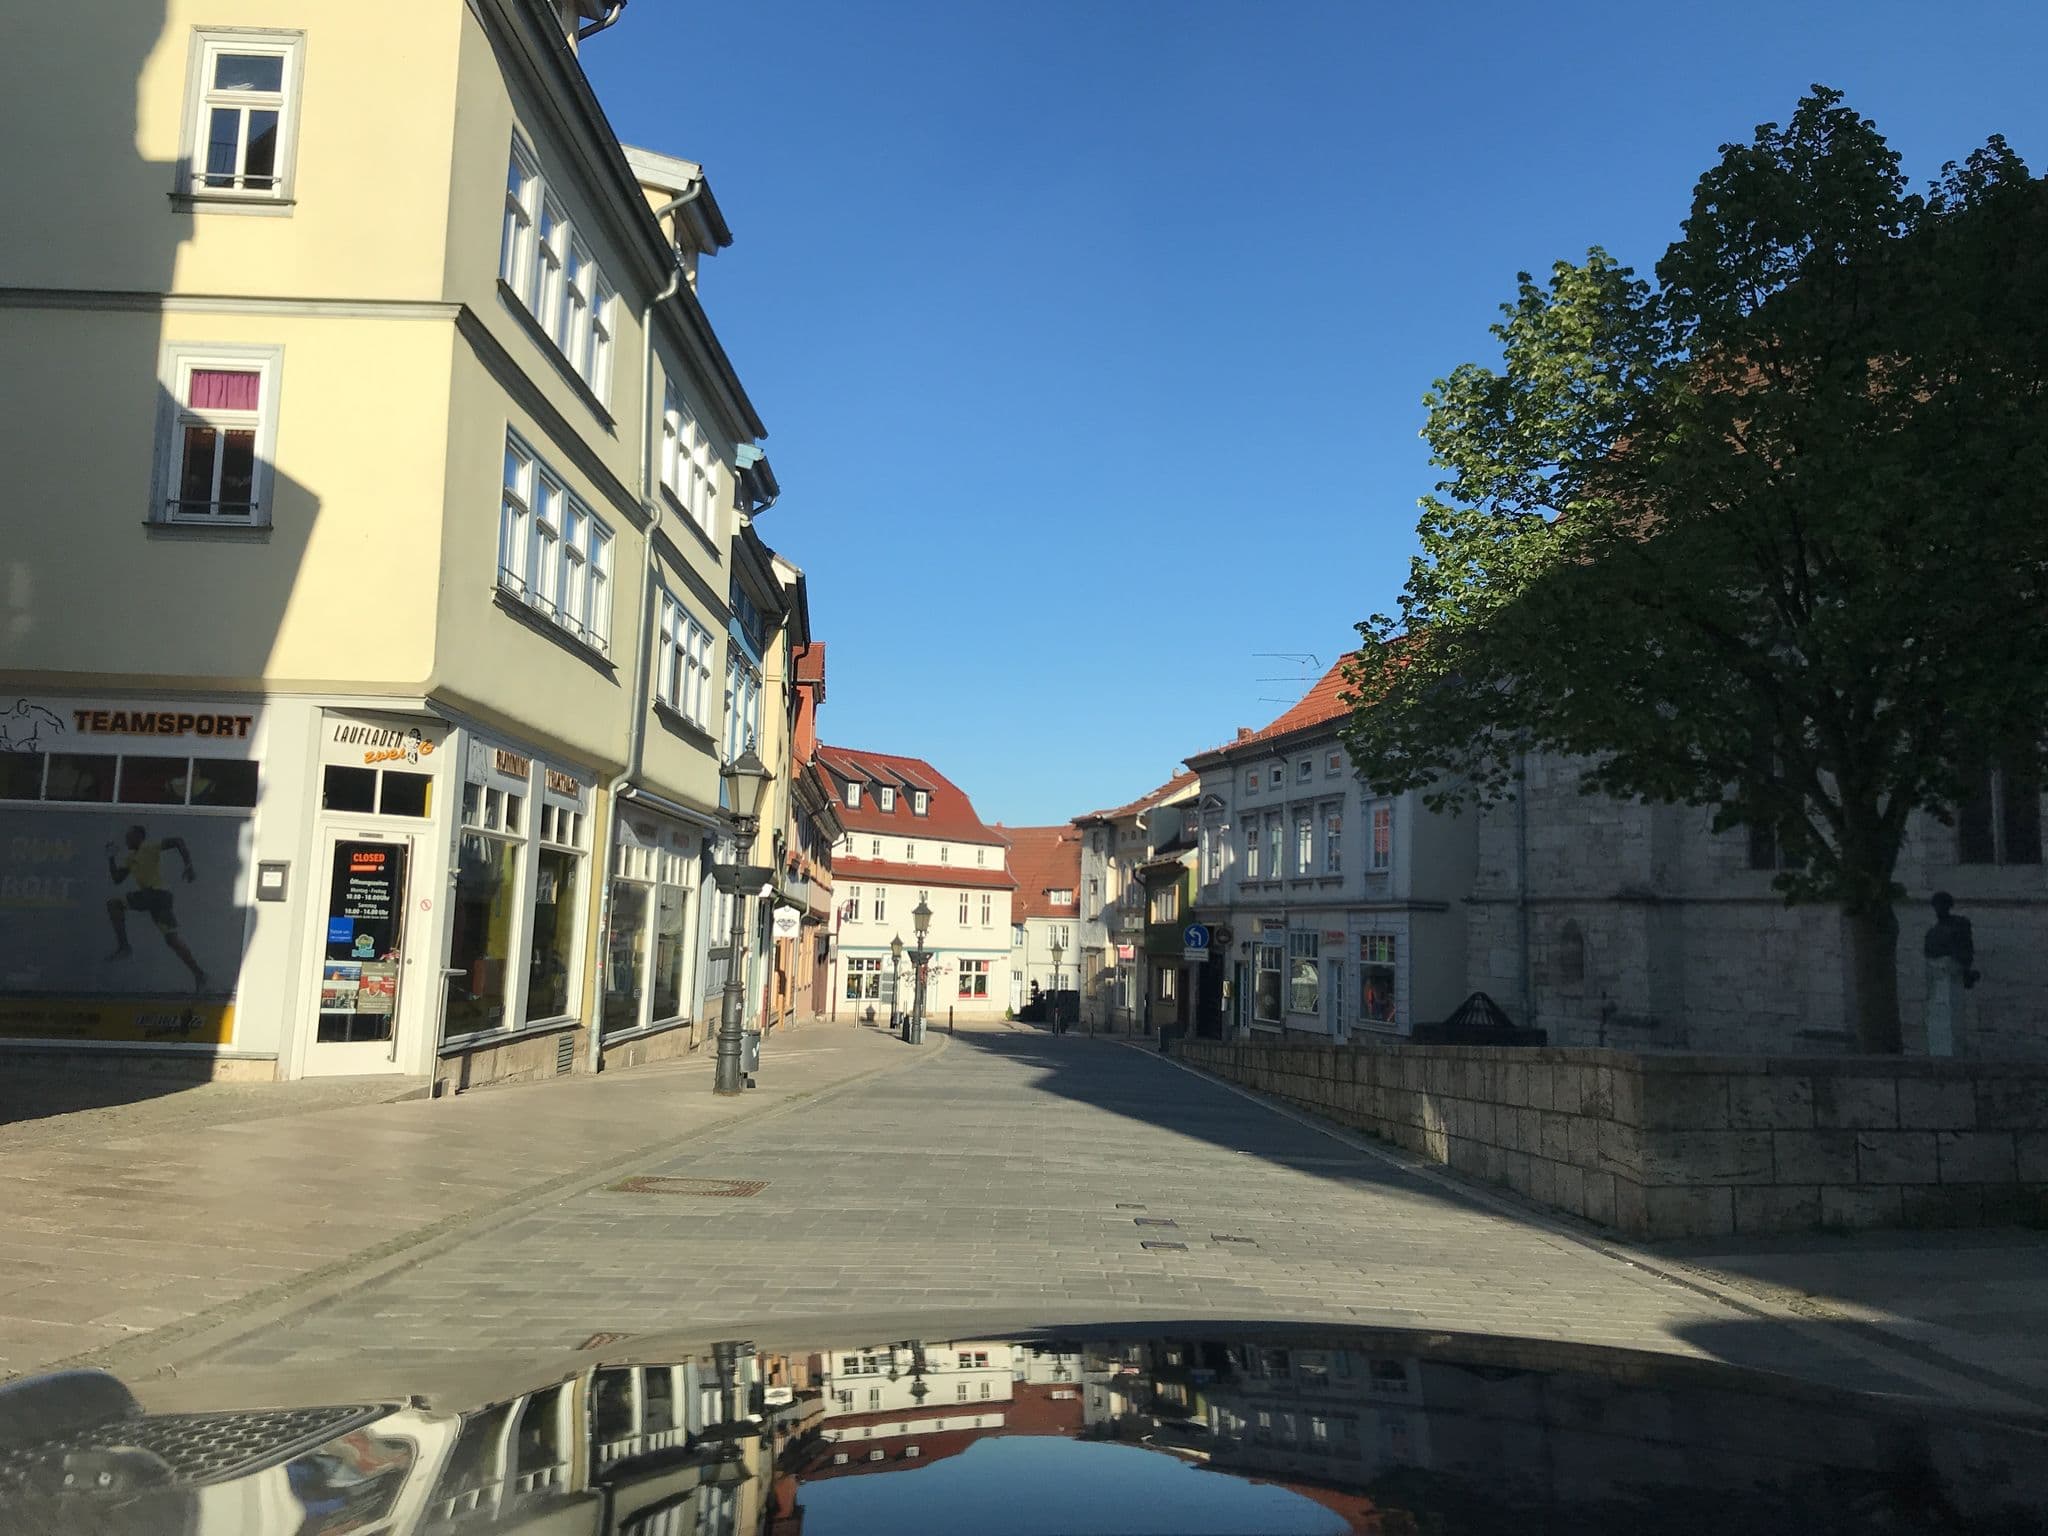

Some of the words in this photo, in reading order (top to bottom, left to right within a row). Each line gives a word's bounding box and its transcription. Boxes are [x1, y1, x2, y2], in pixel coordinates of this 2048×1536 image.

[74, 709, 253, 738] TEAMSPORT
[333, 724, 404, 749] LAUFLADEN
[353, 852, 385, 862] CLOSED
